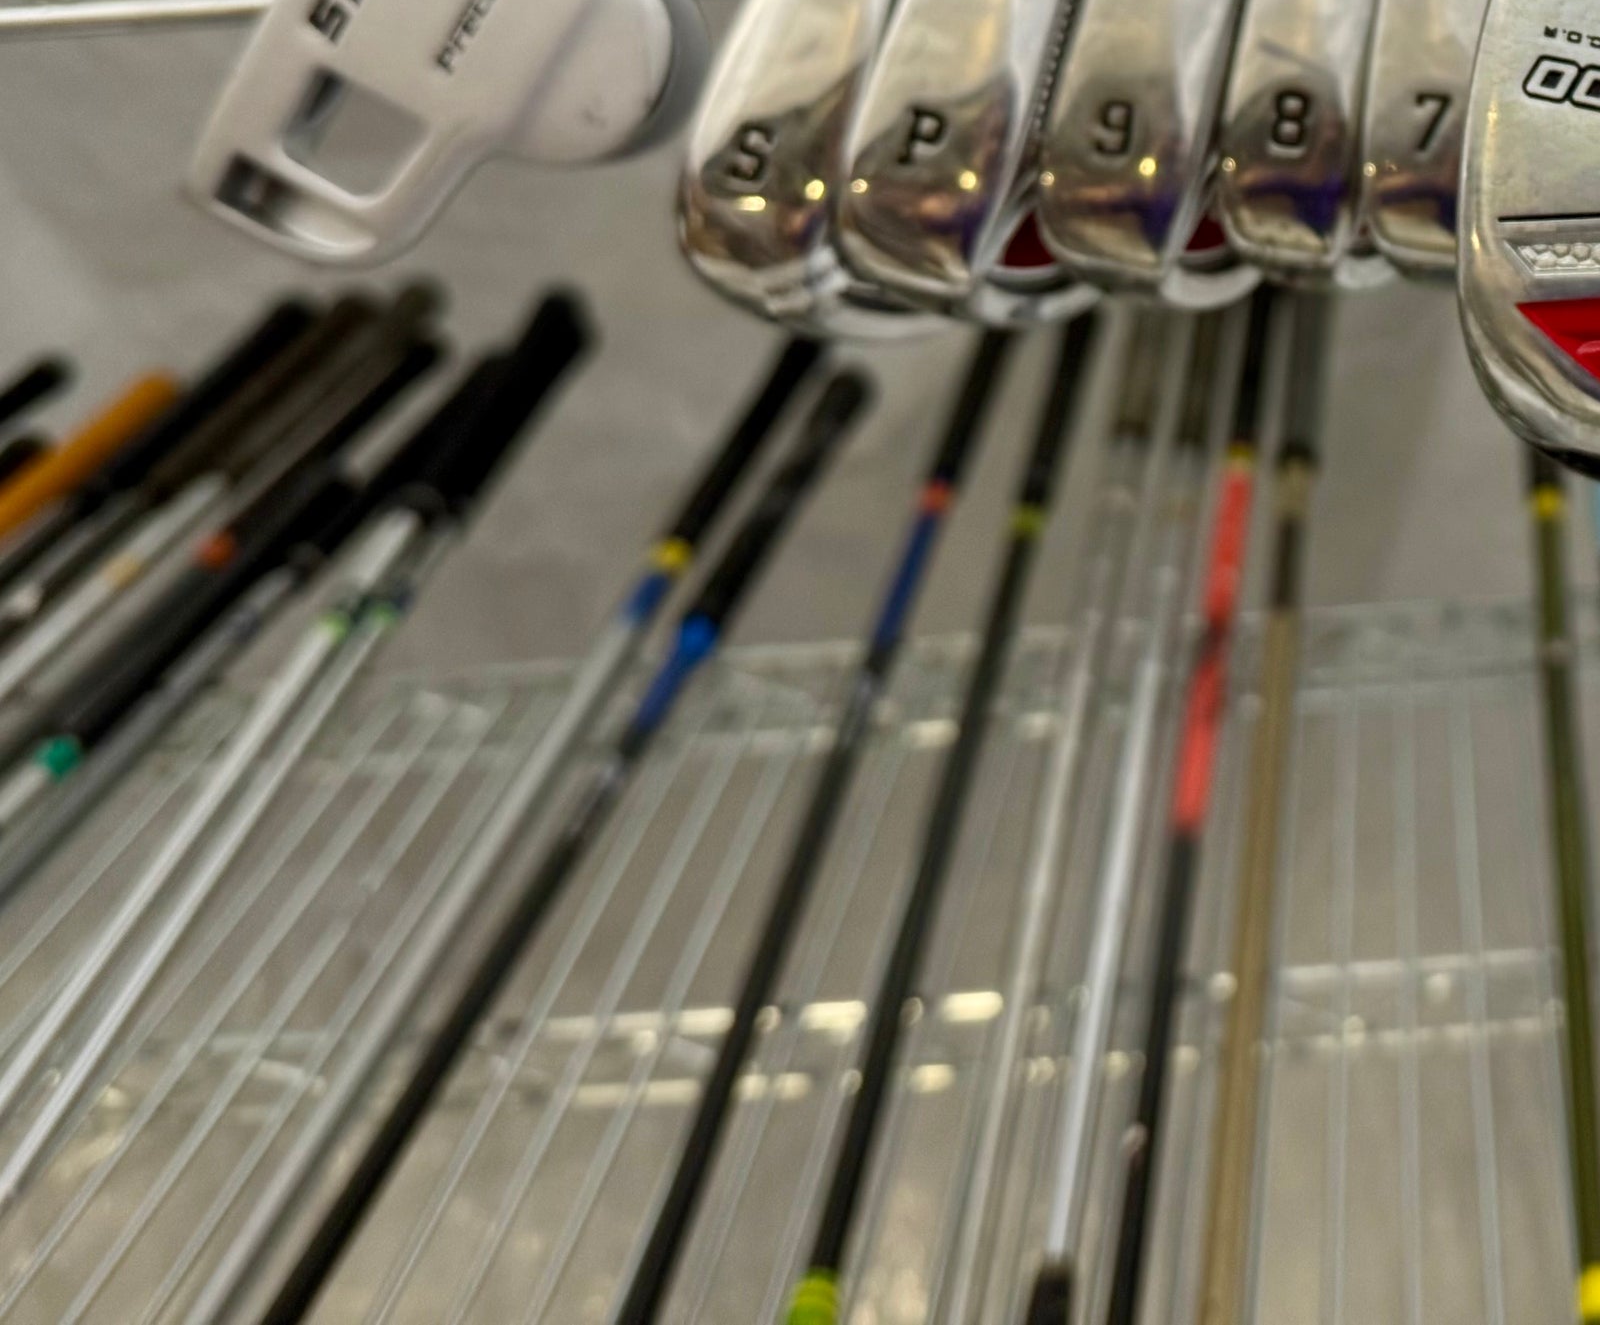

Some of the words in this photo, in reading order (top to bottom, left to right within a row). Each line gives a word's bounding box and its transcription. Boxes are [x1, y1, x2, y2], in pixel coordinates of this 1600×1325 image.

[898, 106, 946, 164] P
[1094, 98, 1134, 156] 9
[1269, 89, 1313, 150] 8
[1413, 90, 1454, 152] 7
[728, 121, 774, 183] S
